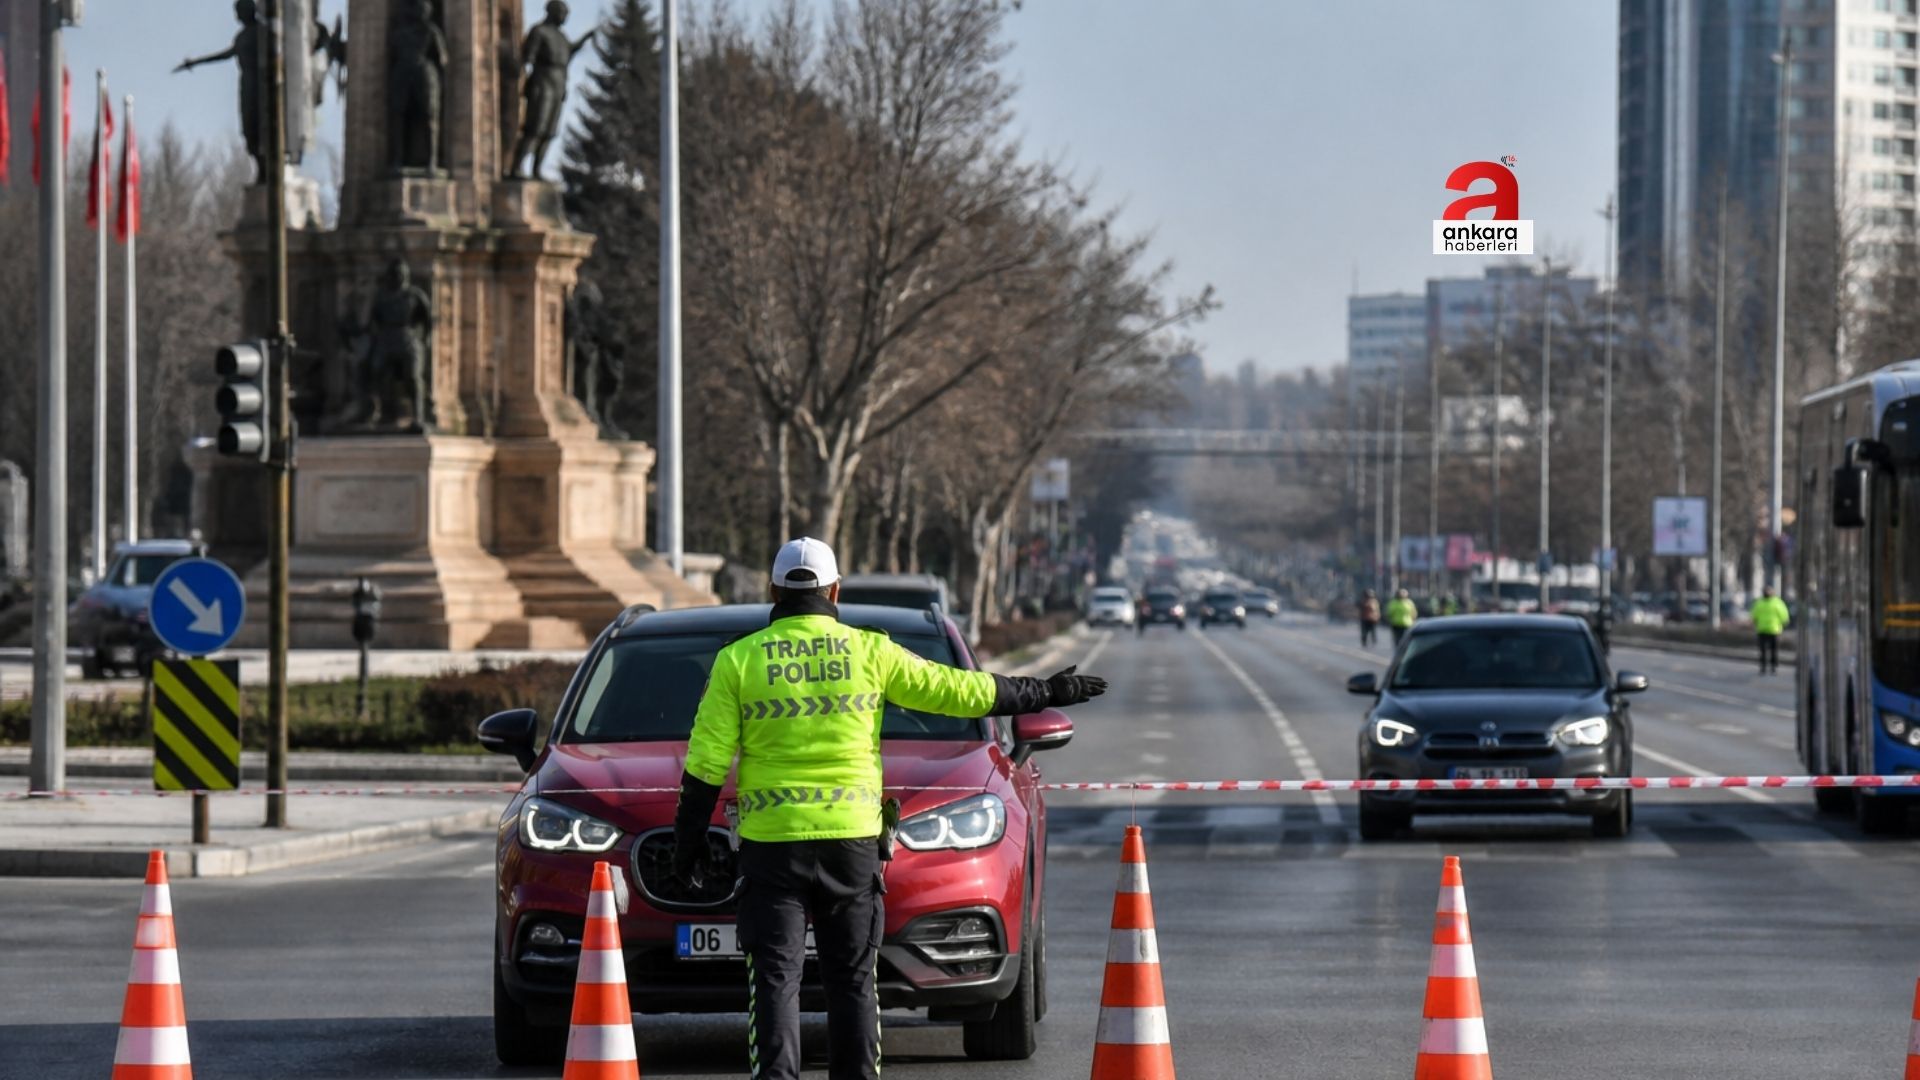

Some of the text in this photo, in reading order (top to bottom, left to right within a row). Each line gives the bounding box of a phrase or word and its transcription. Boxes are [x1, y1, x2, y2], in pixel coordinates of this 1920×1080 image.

[761, 634, 852, 660] TRAFİK
[766, 656, 851, 686] POLİSİ
[692, 928, 721, 952] 06
